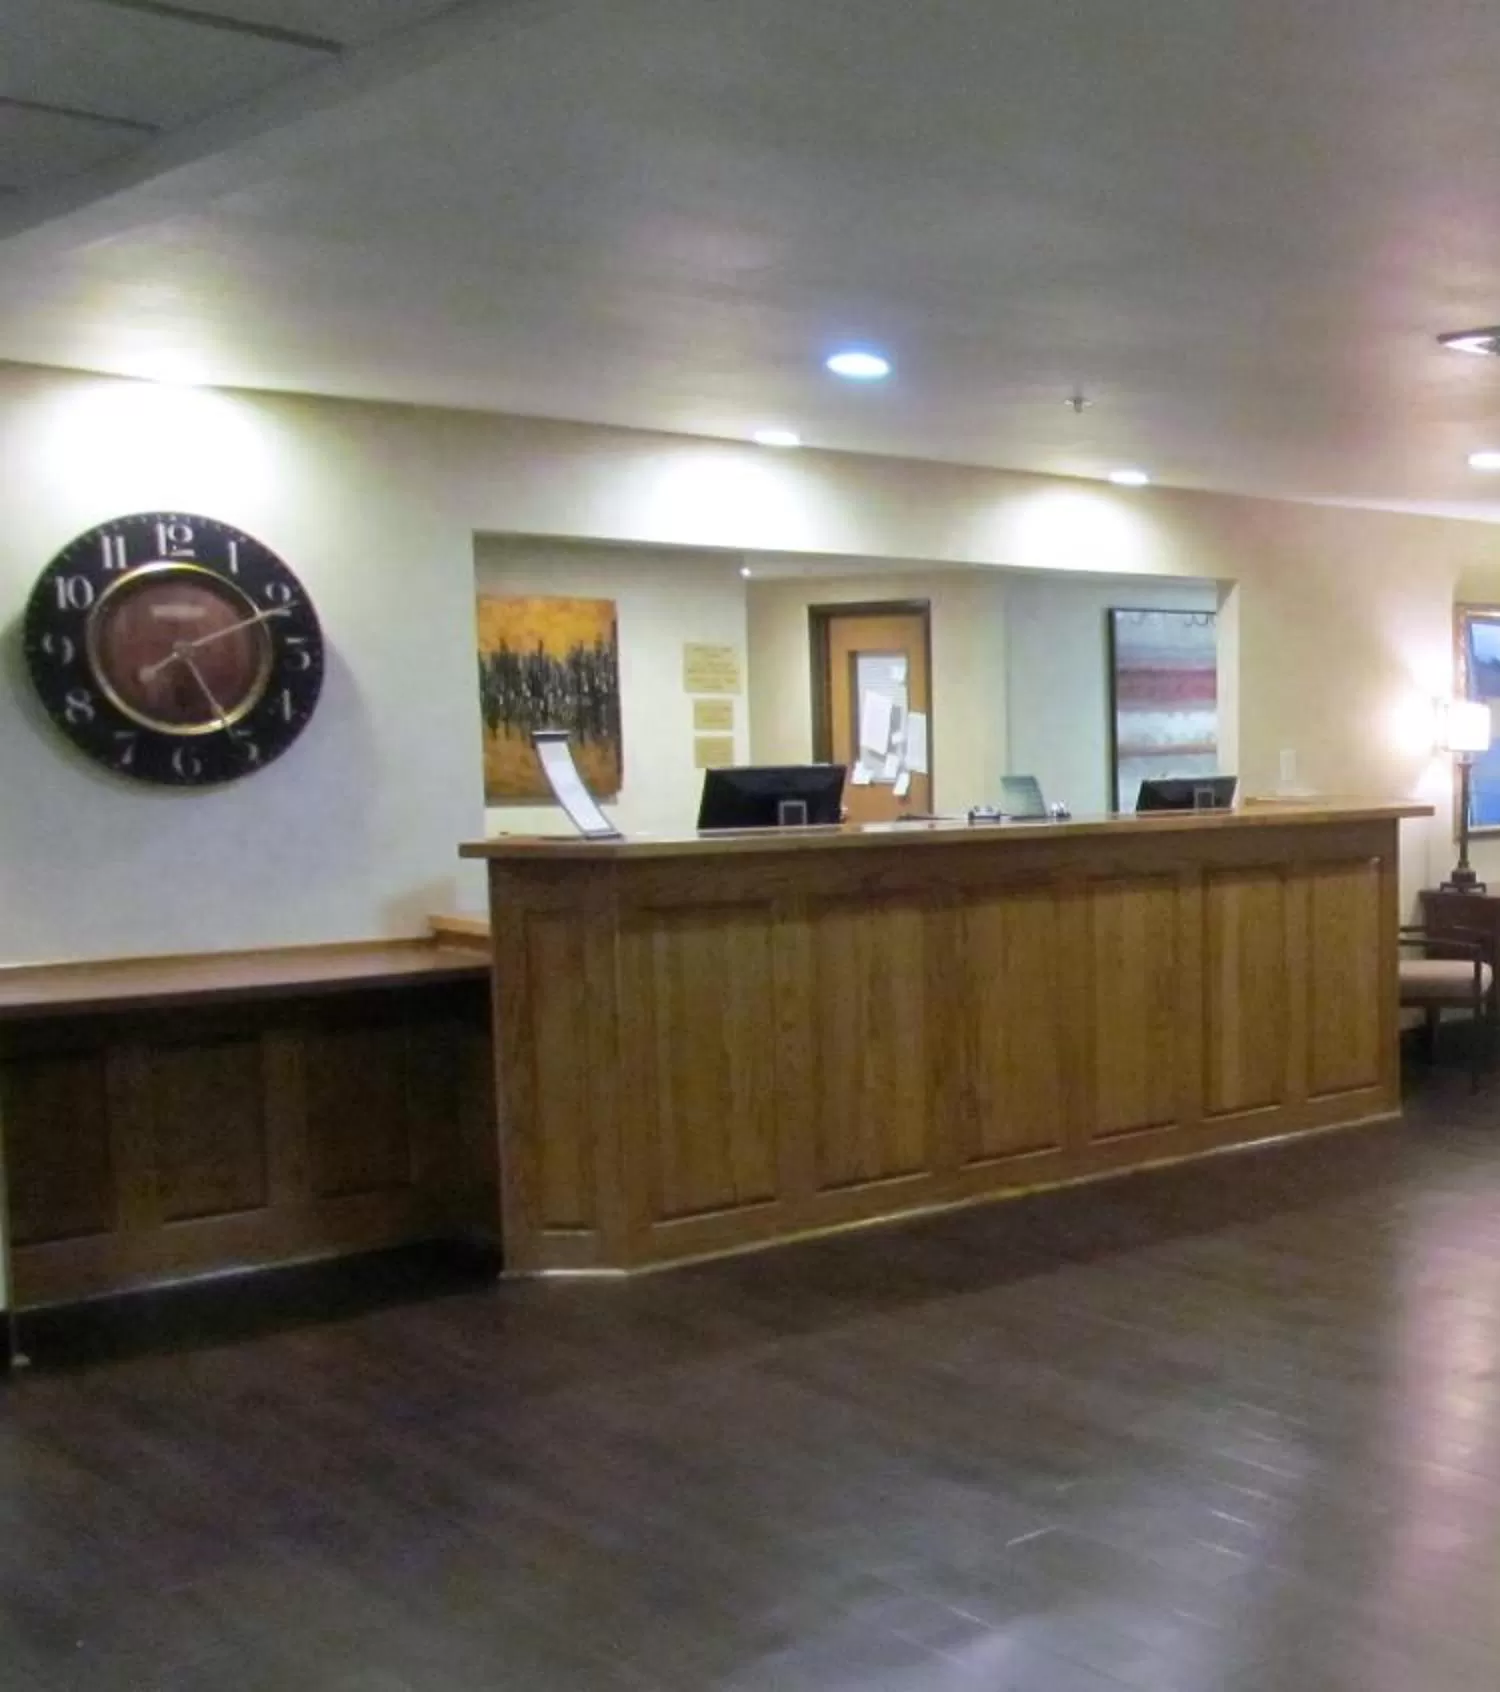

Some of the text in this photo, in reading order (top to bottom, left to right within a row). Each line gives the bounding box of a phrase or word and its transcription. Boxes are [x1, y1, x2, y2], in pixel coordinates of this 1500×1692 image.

[101, 535, 126, 569] 11
[155, 522, 196, 558] 12
[228, 541, 239, 575] 1
[55, 574, 94, 610] 10
[64, 688, 95, 724] 8
[114, 730, 137, 765] 7
[171, 748, 201, 778] 6
